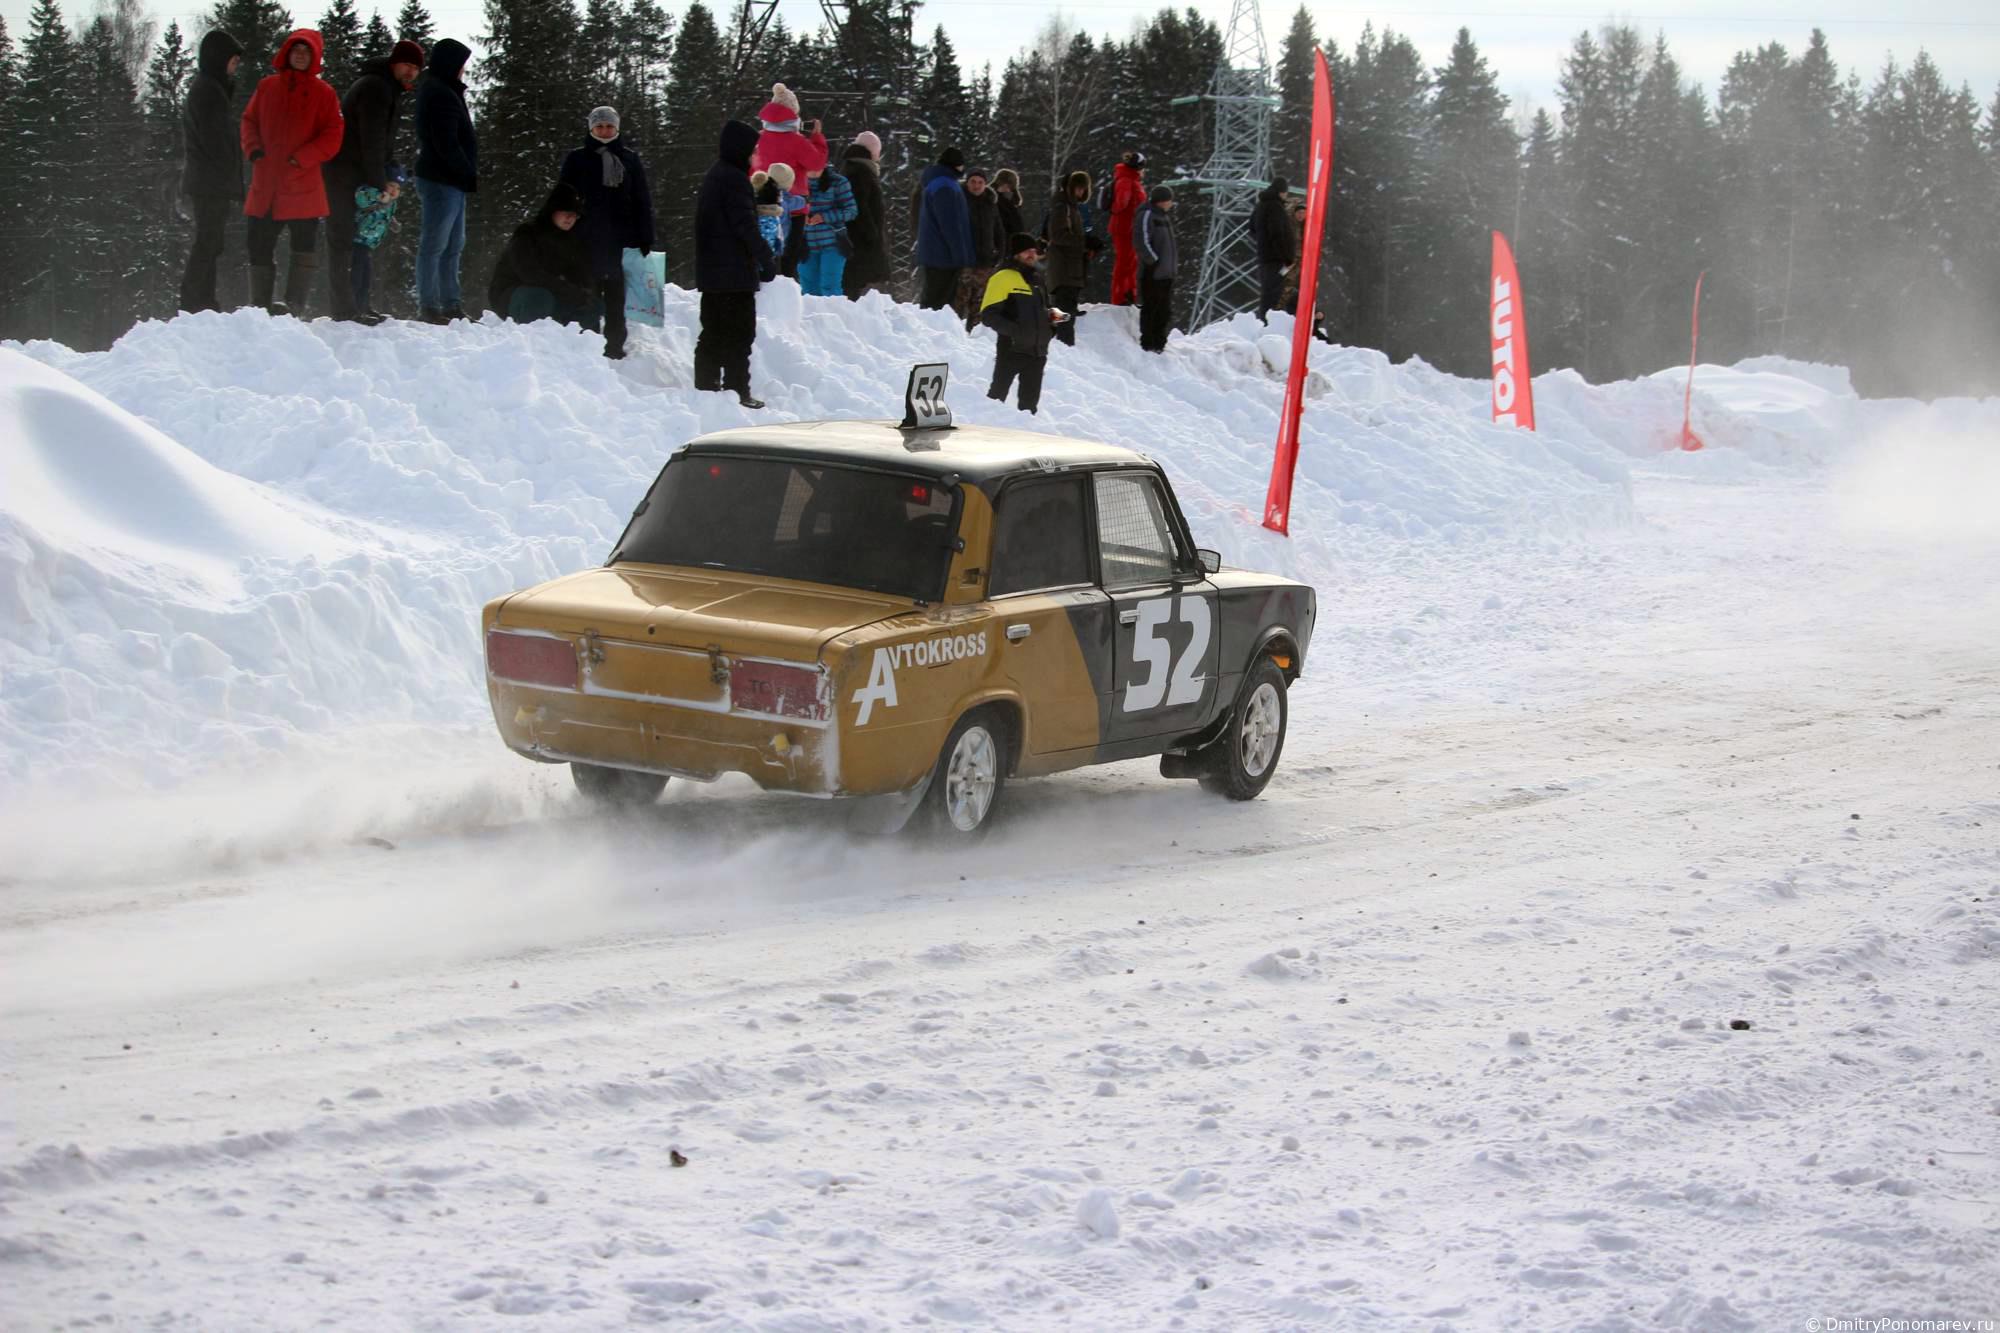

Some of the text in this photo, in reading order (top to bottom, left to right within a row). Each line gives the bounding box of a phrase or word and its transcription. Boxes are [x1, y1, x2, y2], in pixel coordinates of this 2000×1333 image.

[916, 376, 947, 417] 52
[851, 631, 986, 726] AVTOKROSS
[1123, 595, 1211, 712] 52
